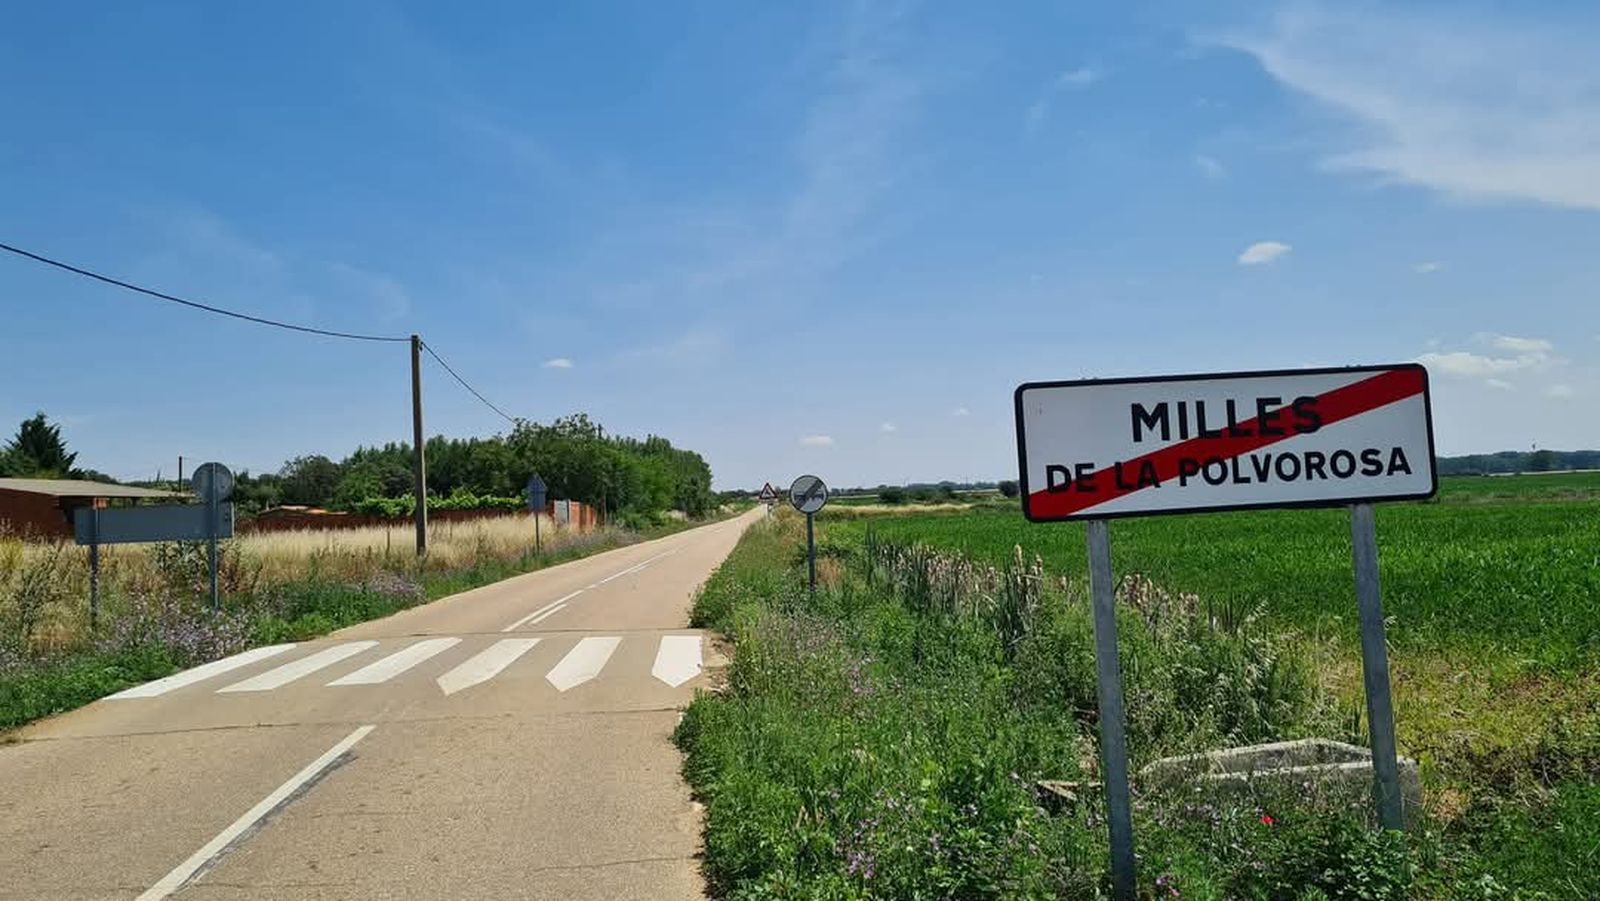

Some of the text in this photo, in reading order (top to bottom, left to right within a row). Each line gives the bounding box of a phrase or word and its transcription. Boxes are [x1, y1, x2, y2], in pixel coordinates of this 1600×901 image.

[1131, 396, 1323, 442] MILLES
[1046, 447, 1412, 494] DE LA POLVOROSA
